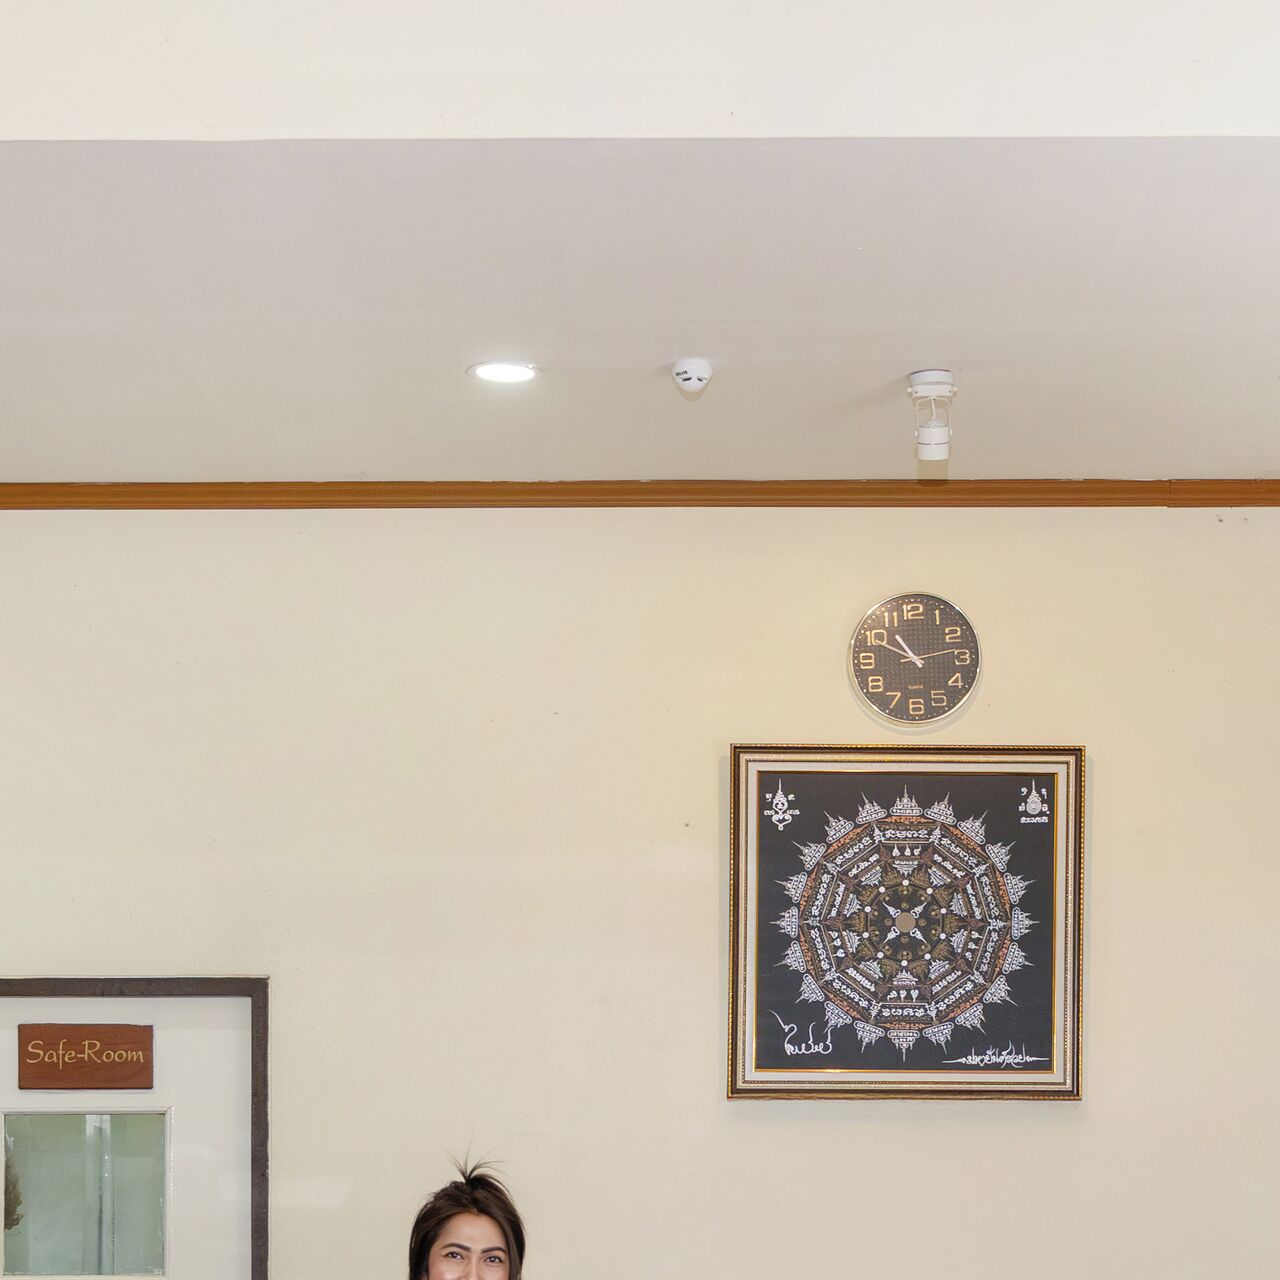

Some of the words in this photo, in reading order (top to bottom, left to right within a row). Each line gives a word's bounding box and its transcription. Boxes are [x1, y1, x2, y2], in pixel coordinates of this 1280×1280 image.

[884, 611, 898, 627] 11
[902, 603, 925, 620] 12
[934, 609, 940, 625] 1
[865, 629, 887, 646] 10
[945, 626, 962, 643] 2
[859, 652, 875, 669] 9
[954, 649, 970, 665] 3
[868, 675, 883, 692] 8
[948, 672, 964, 688] 4
[885, 692, 901, 708] 7
[908, 698, 924, 715] 6
[930, 690, 947, 707] 5
[26, 1039, 144, 1070] Safe-Room
